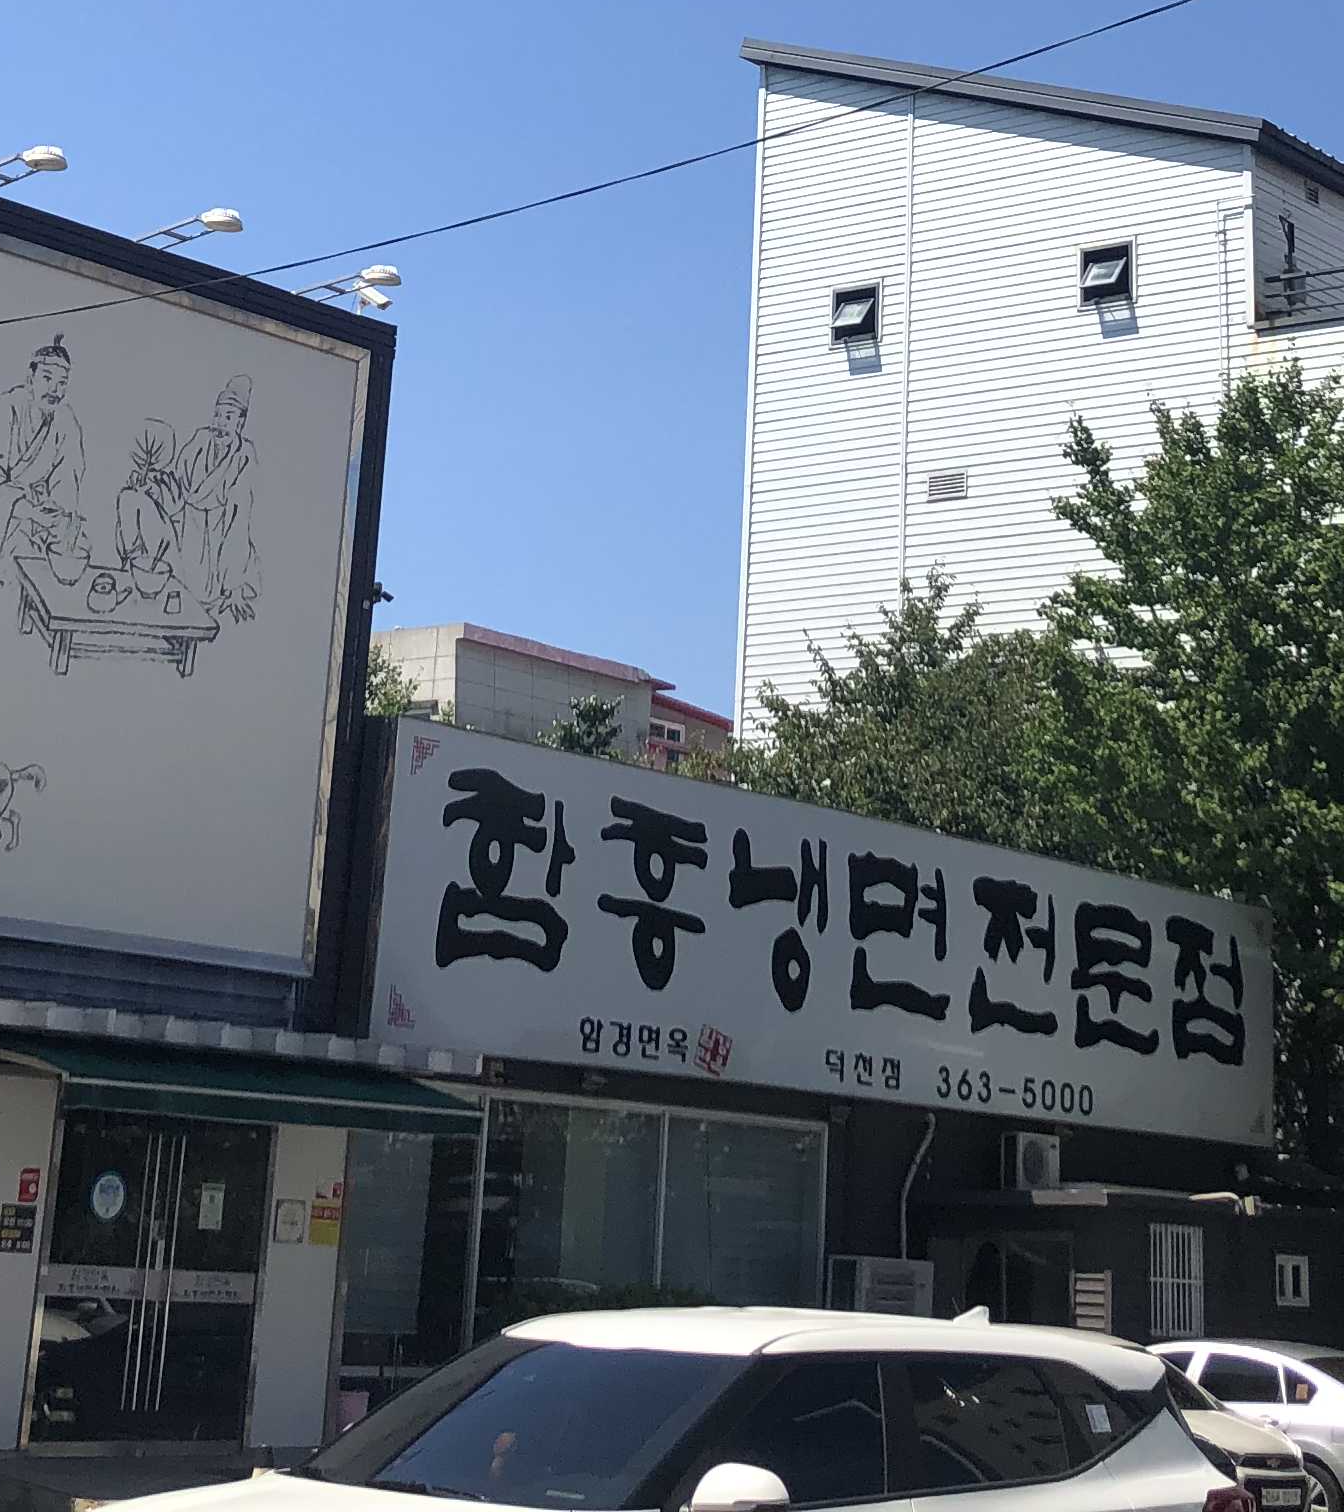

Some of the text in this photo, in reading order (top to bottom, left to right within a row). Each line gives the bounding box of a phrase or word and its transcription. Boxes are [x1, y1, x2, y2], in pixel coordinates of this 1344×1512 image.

[435, 767, 1246, 1068] 함흥냉면전문점
[824, 1048, 1095, 1117] 덕천점 363-5000
